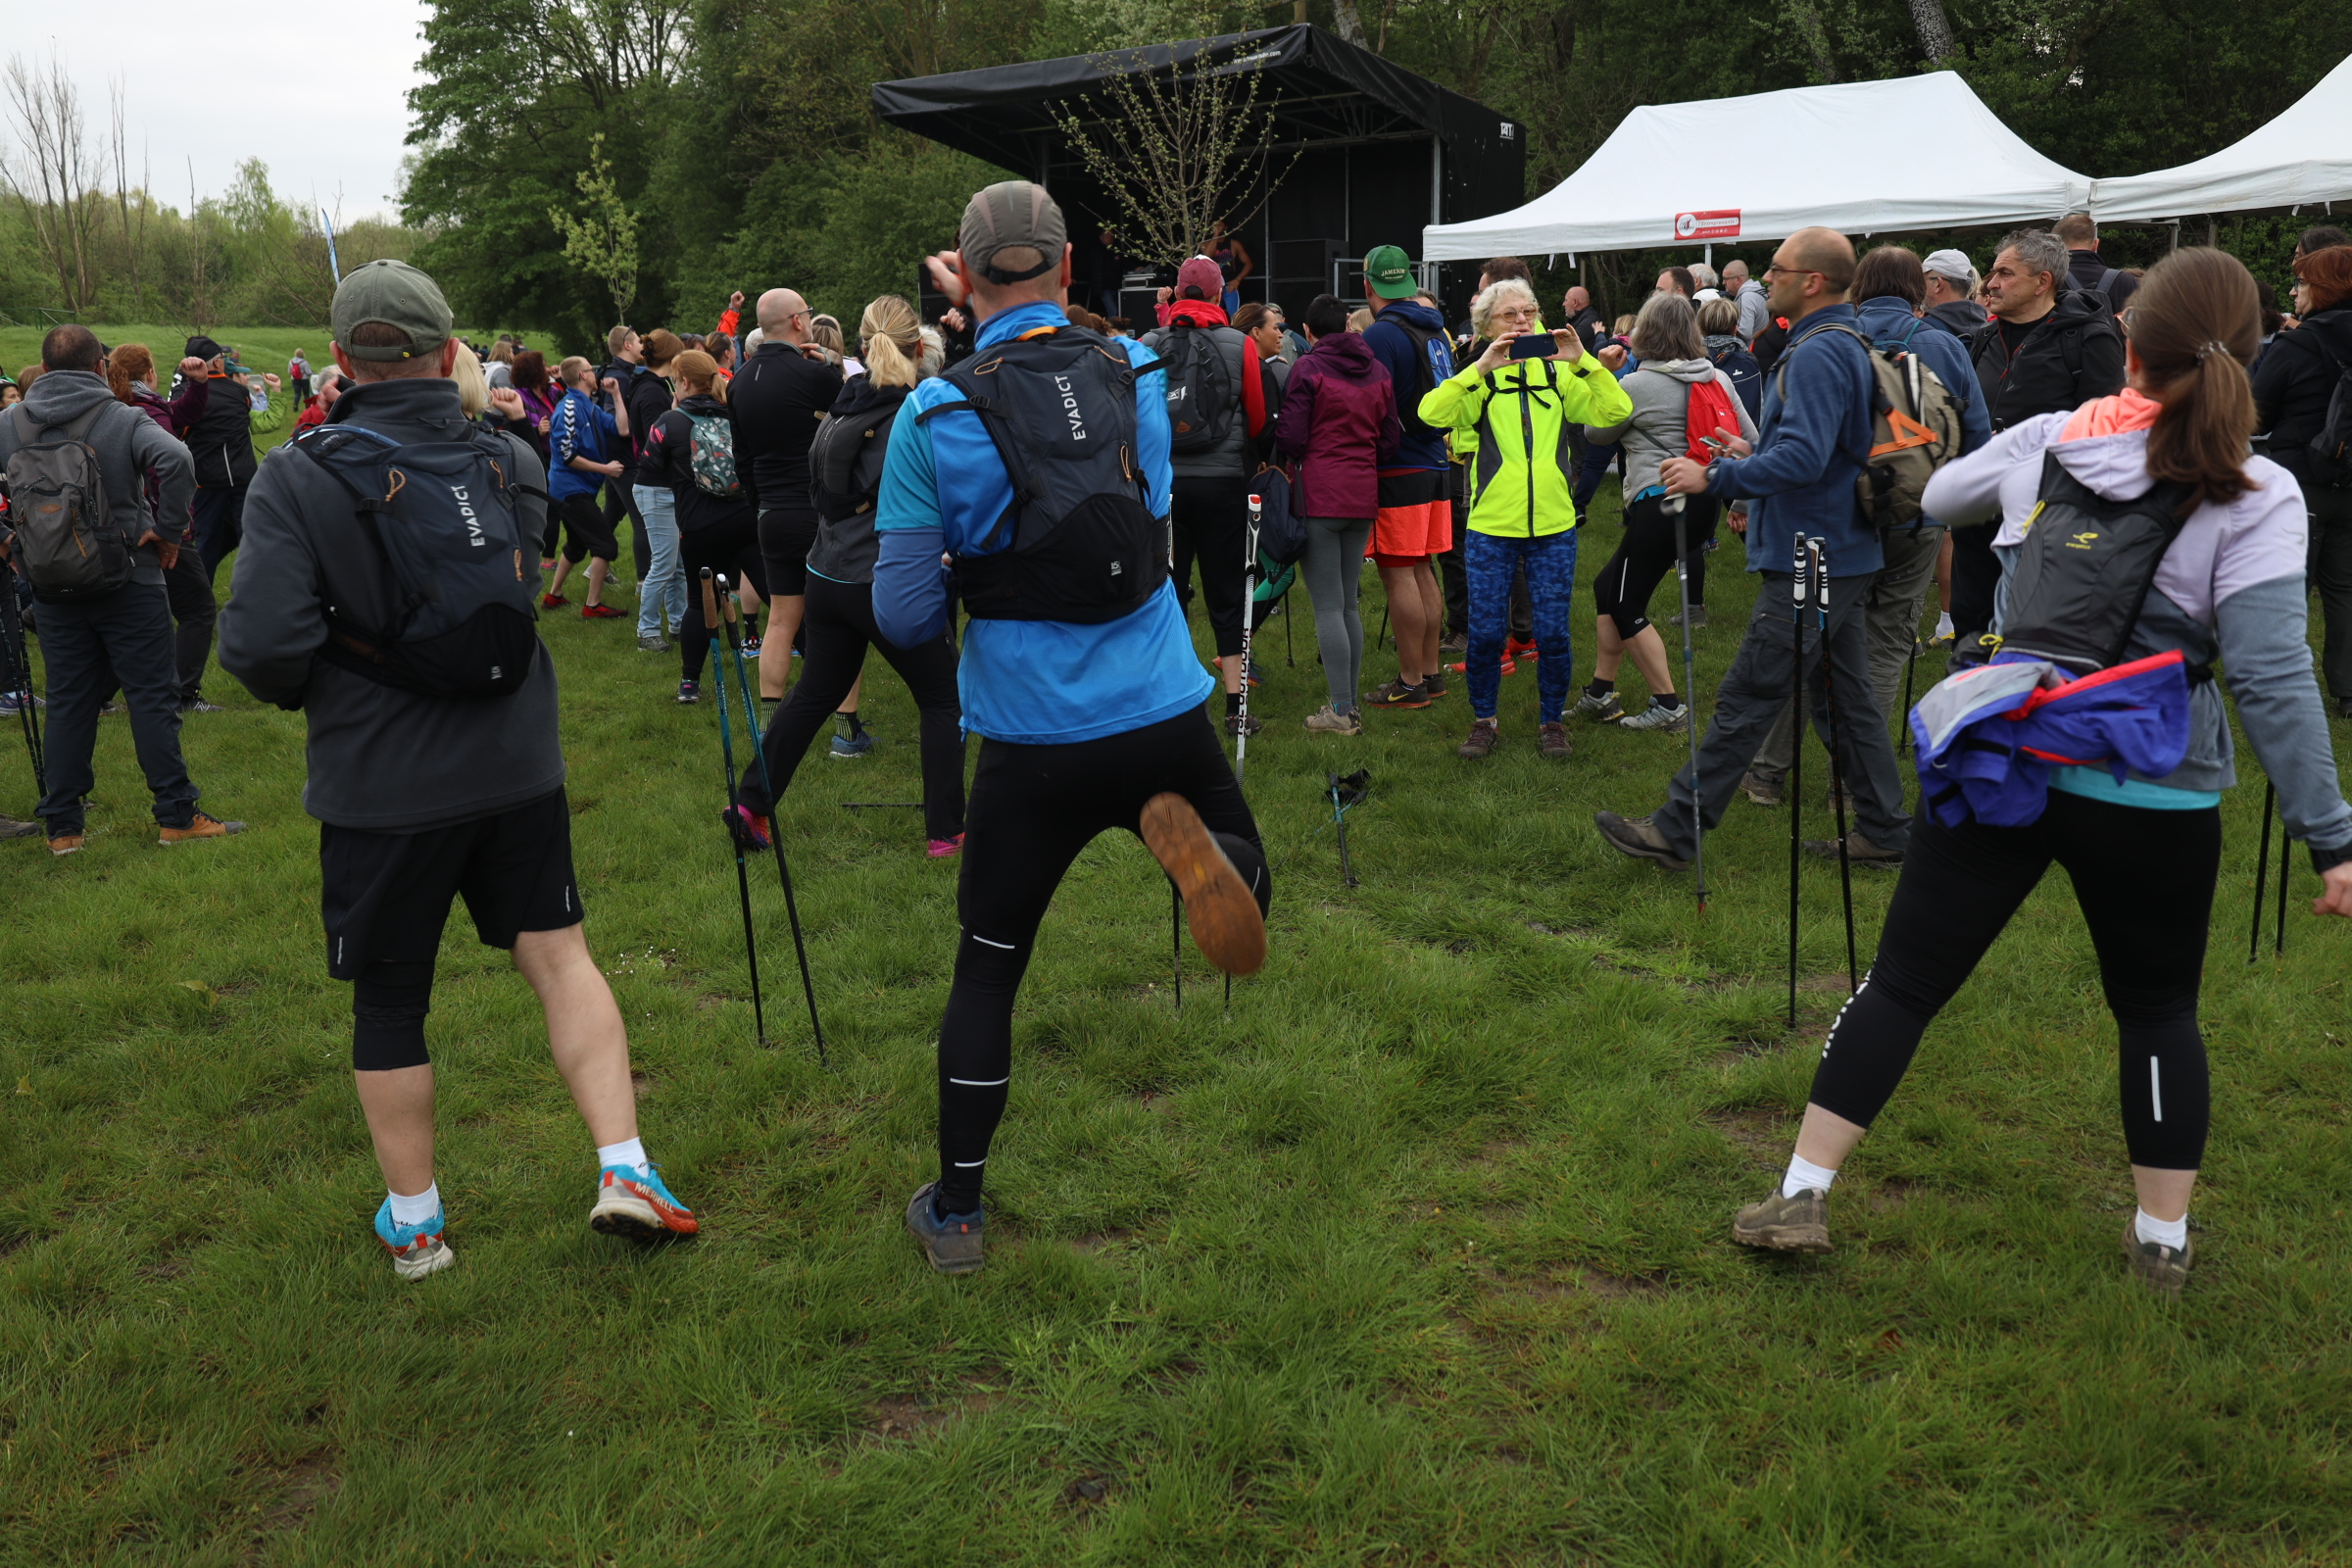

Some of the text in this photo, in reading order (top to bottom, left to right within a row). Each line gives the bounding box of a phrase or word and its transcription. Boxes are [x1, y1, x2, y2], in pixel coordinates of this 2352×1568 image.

[1381, 268, 1406, 276] JAMESON
[1054, 375, 1087, 441] EVADICT
[451, 485, 486, 547] EVADICT
[635, 1182, 674, 1213] MERRELL
